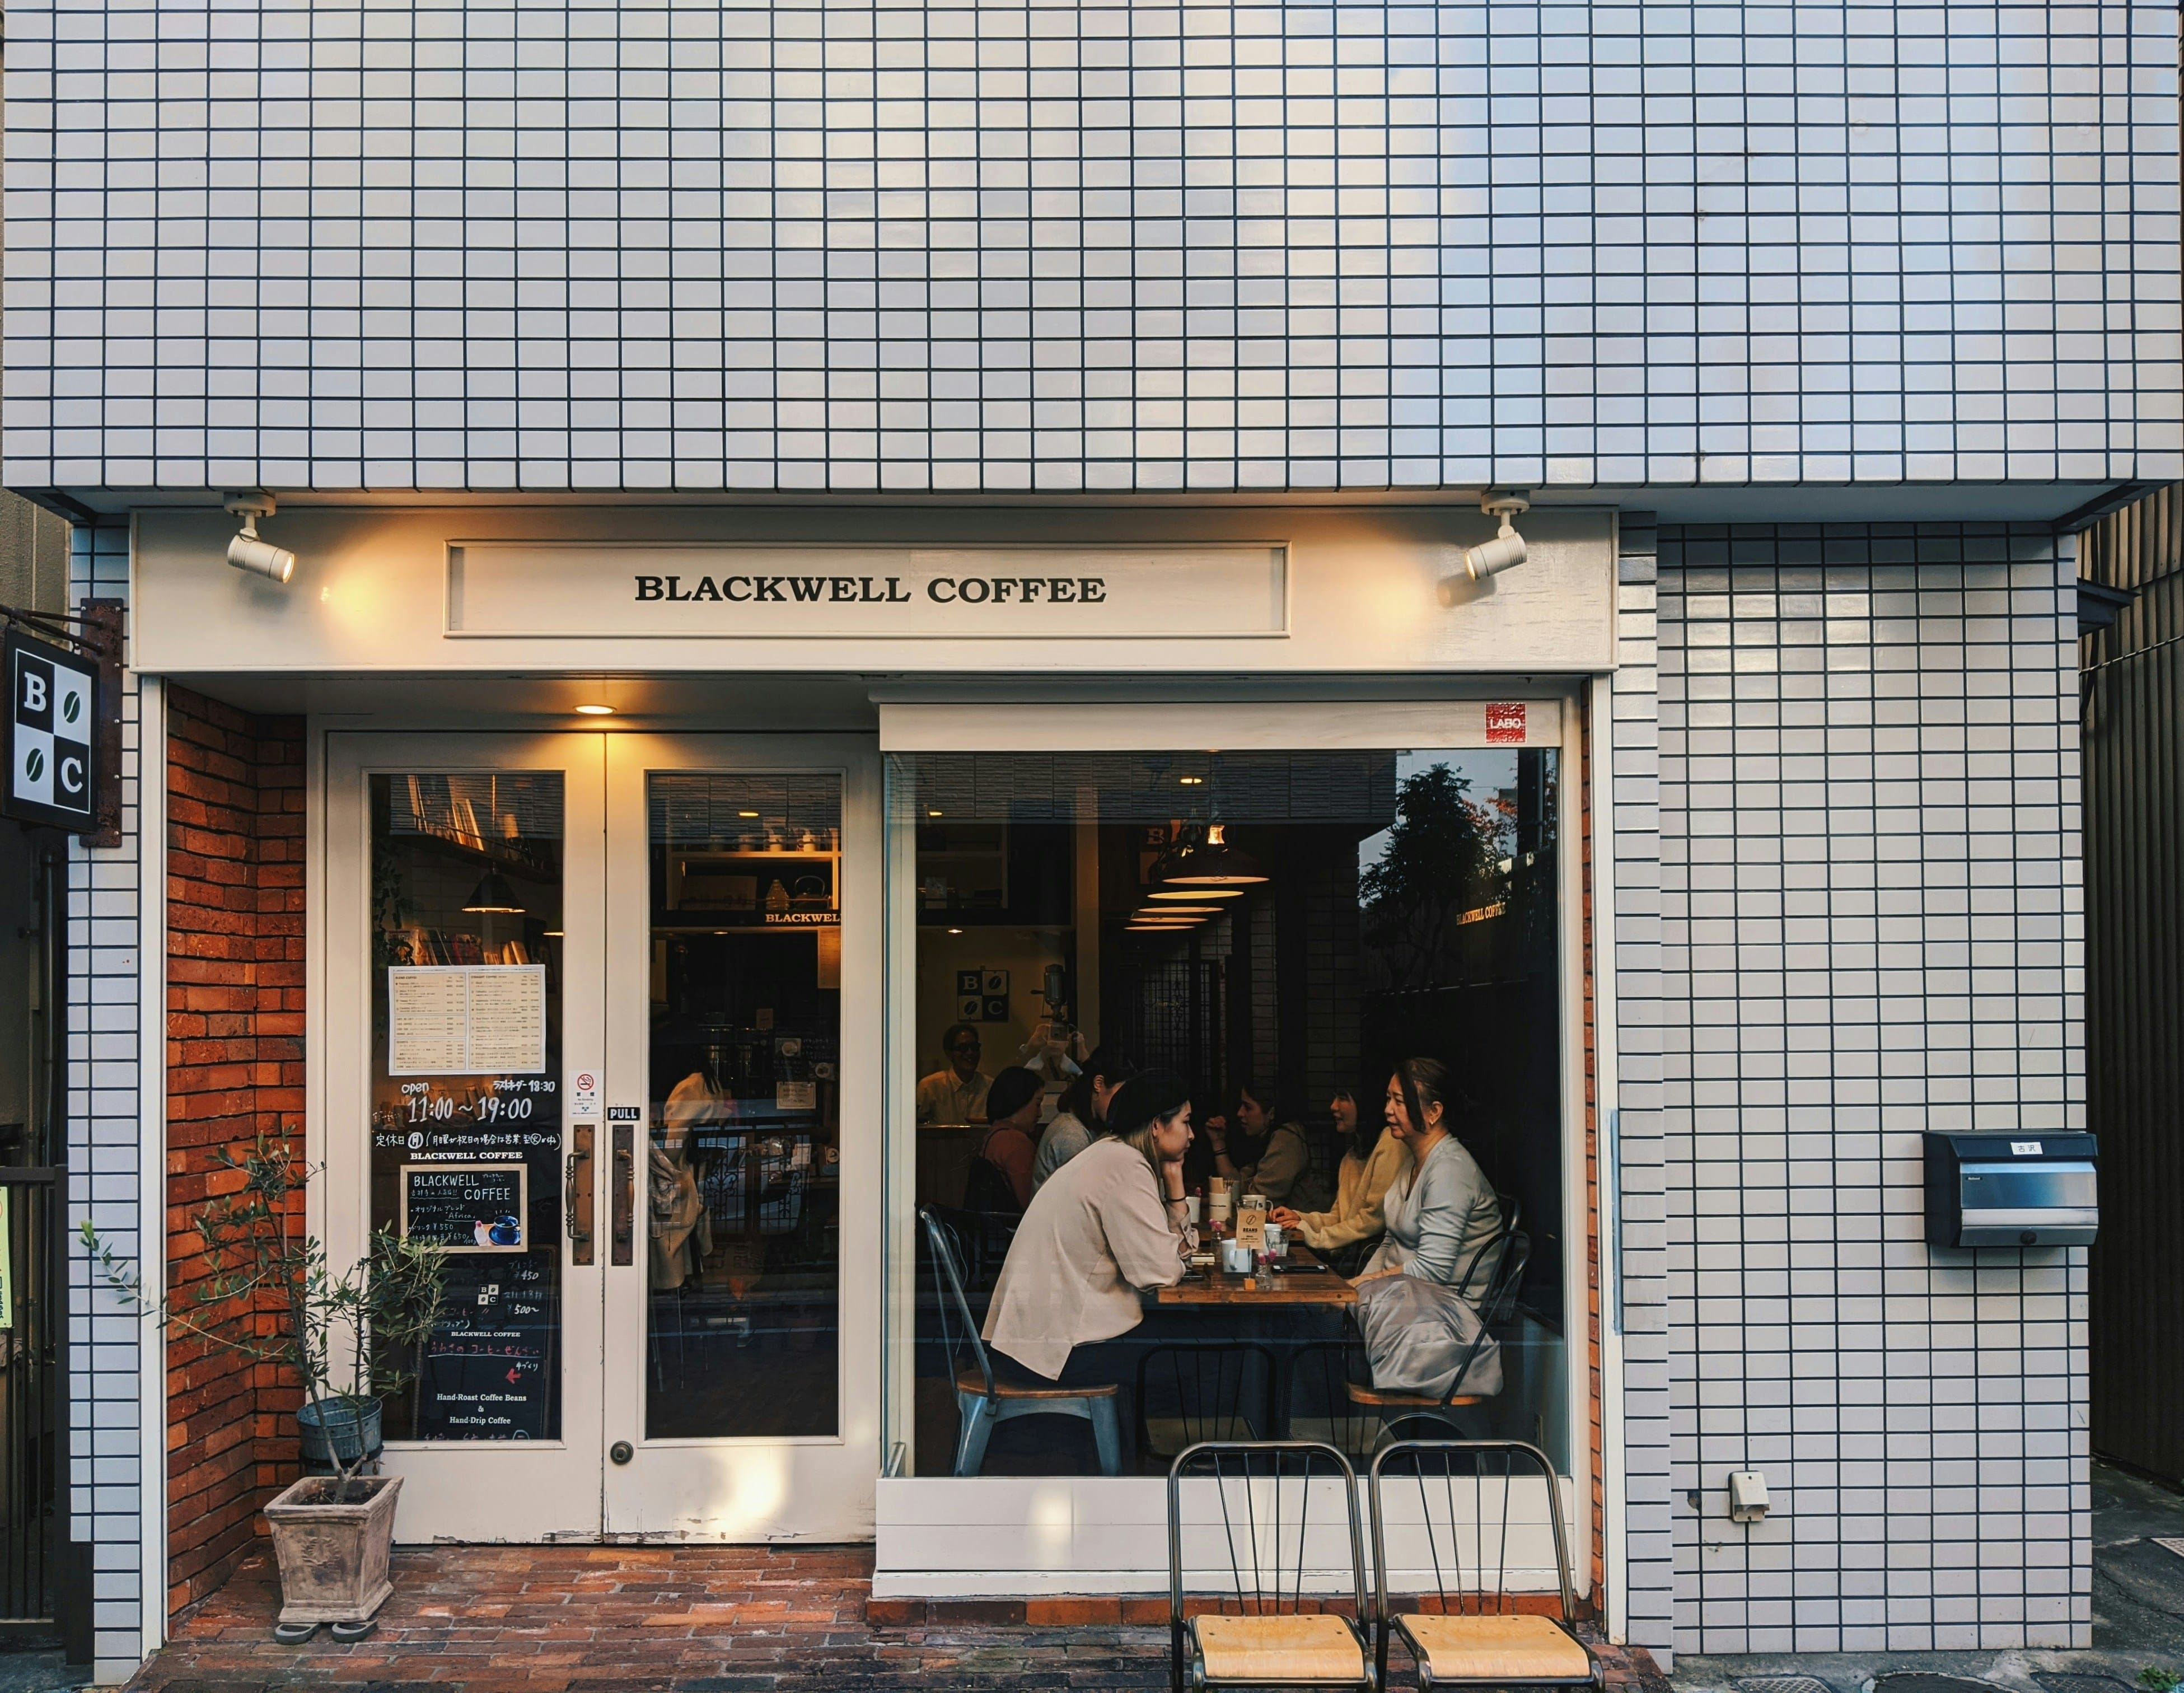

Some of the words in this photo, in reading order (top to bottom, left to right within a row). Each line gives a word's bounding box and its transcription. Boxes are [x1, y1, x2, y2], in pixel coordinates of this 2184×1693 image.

[634, 576, 911, 602] BLACKWELL
[927, 577, 1107, 603] COFFEE
[24, 672, 47, 712] B
[1490, 718, 1521, 729] LABO
[60, 757, 83, 793] C
[765, 914, 842, 922] BLACKWEL
[963, 976, 978, 990] B
[401, 1082, 429, 1095] open
[528, 1079, 555, 1092] 18:30
[408, 1096, 453, 1123] 11:00
[477, 1096, 532, 1123] 19:00
[610, 1109, 637, 1119] PULL
[414, 1175, 479, 1187] BLACKWELL
[464, 1187, 511, 1201] COFFEE
